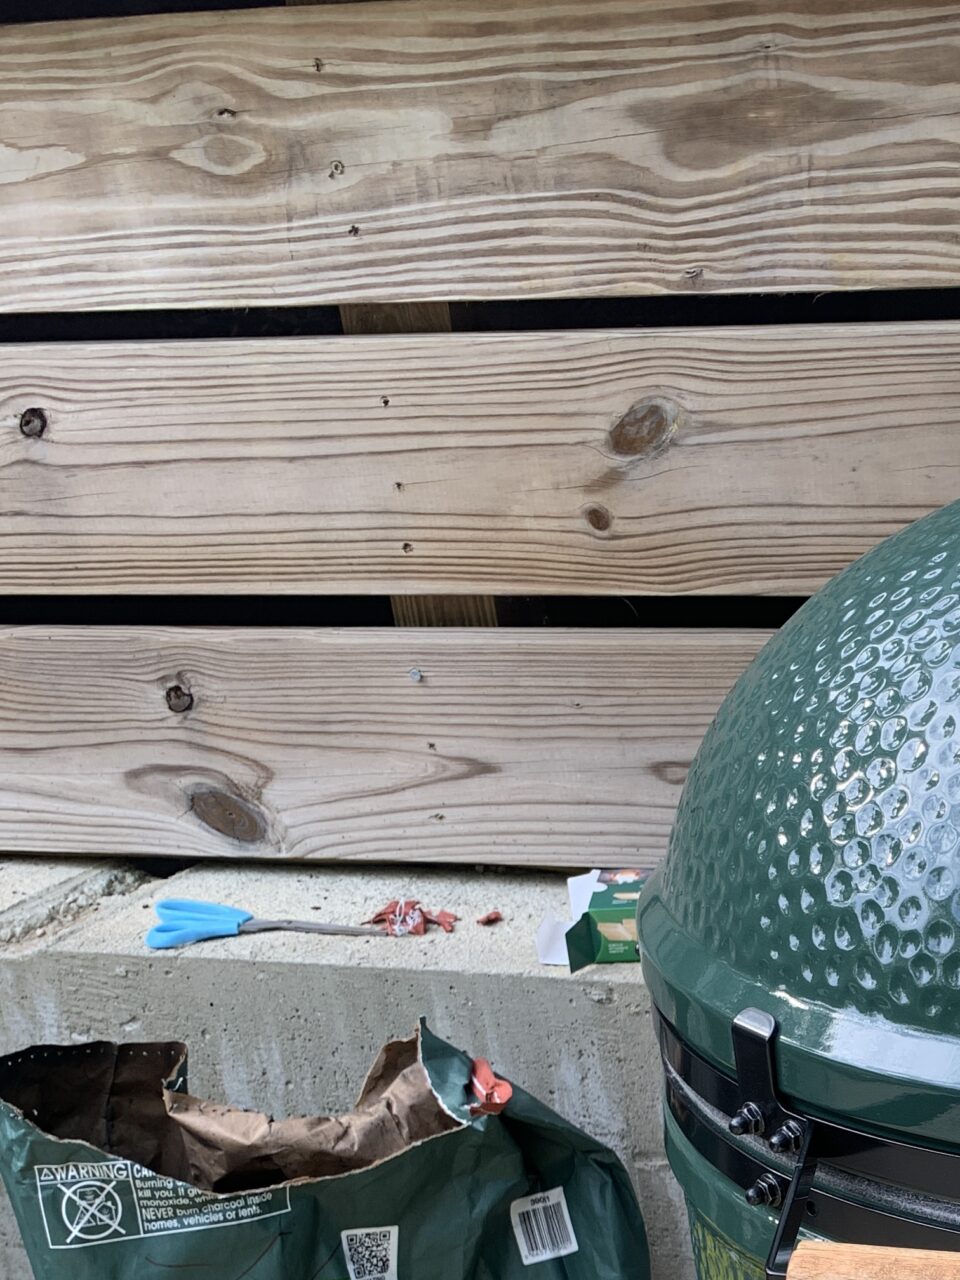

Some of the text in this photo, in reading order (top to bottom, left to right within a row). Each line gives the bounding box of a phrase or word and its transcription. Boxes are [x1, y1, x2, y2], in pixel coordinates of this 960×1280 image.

[53, 1163, 128, 1180] WARNING
[138, 1188, 151, 1198] kill
[154, 1190, 176, 1199] you.
[141, 1207, 174, 1220] NEVER
[201, 1199, 245, 1213] charcoal
[143, 1219, 181, 1232] homes,
[183, 1212, 224, 1226] vehicles
